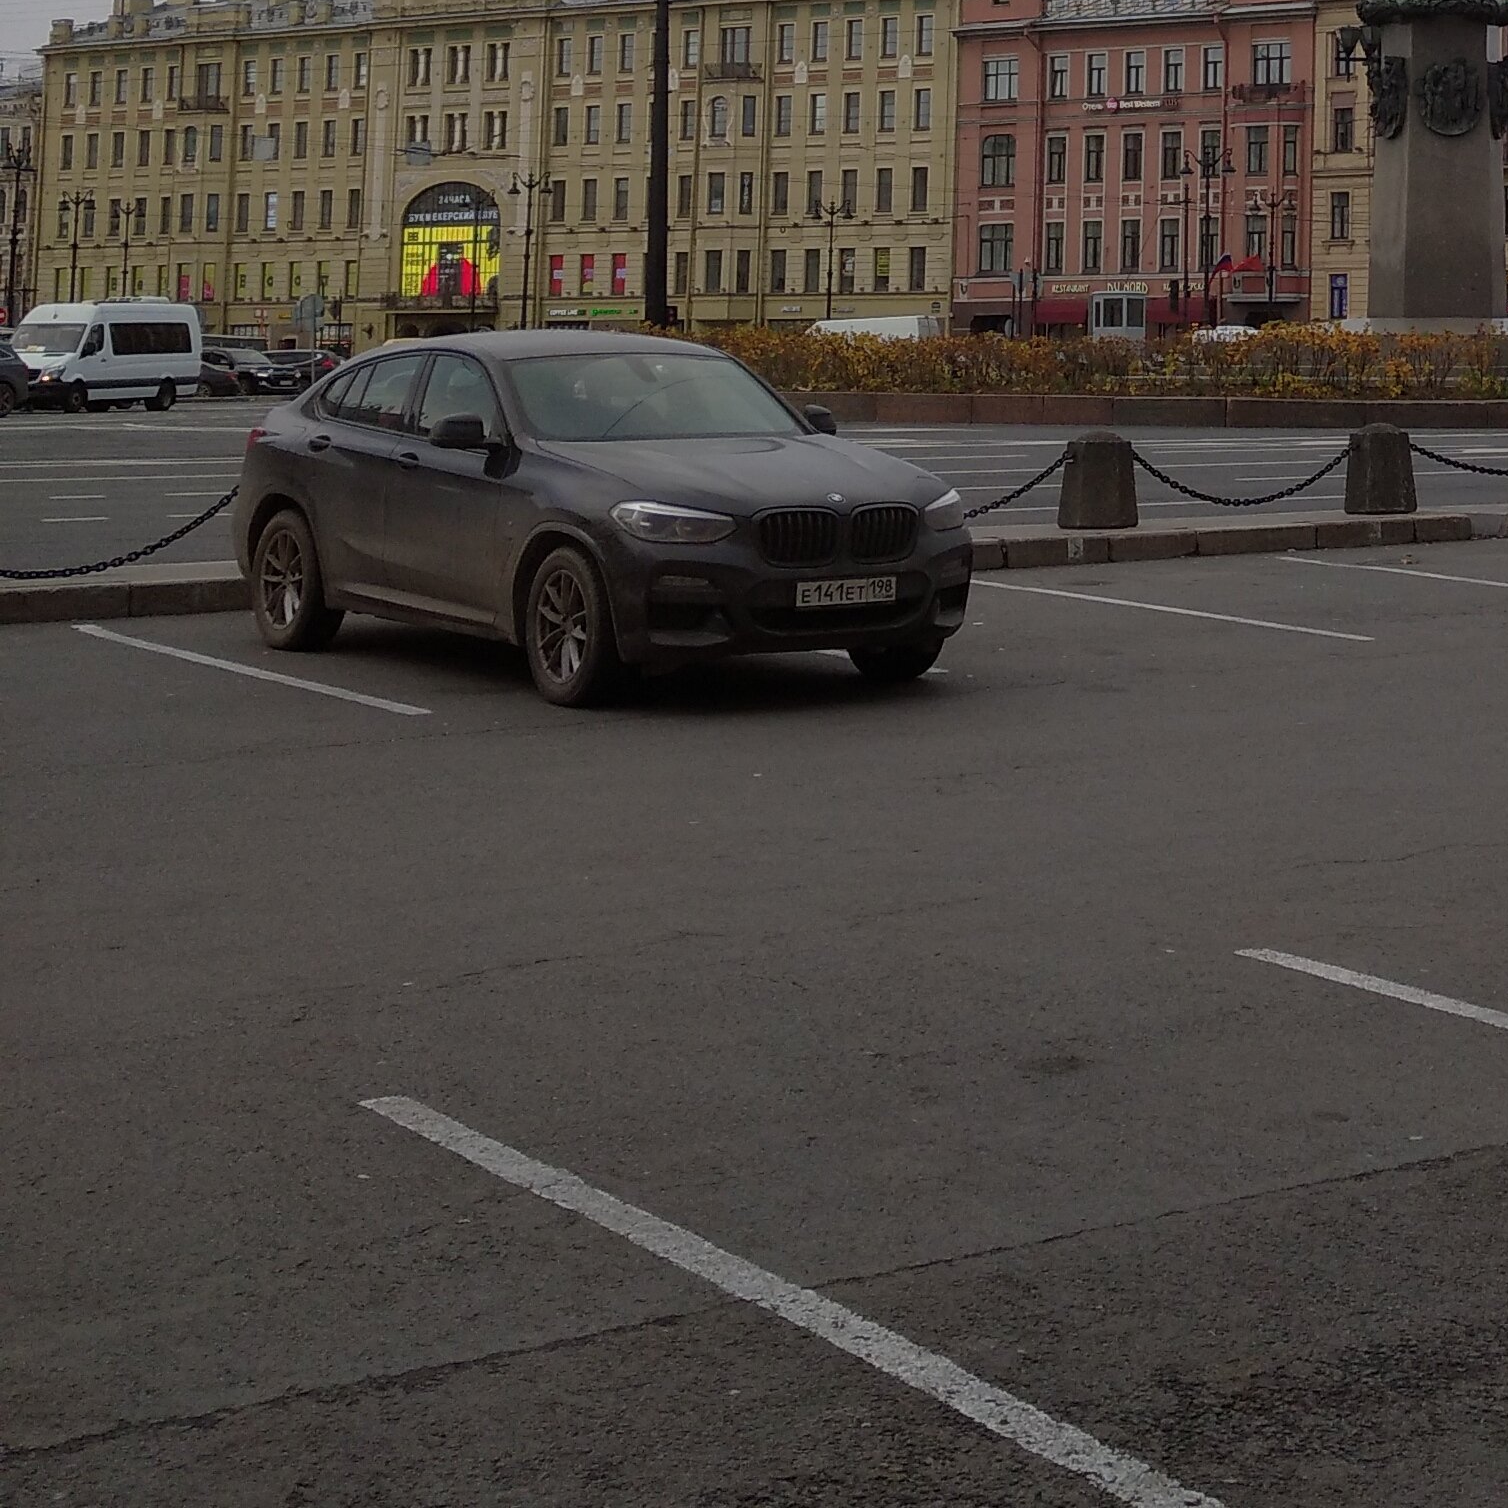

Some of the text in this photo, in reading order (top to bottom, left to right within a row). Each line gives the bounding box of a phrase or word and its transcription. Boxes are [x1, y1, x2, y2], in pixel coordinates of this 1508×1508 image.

[1119, 100, 1133, 109] Best
[1123, 281, 1148, 294] NORD
[869, 579, 893, 594] 198
